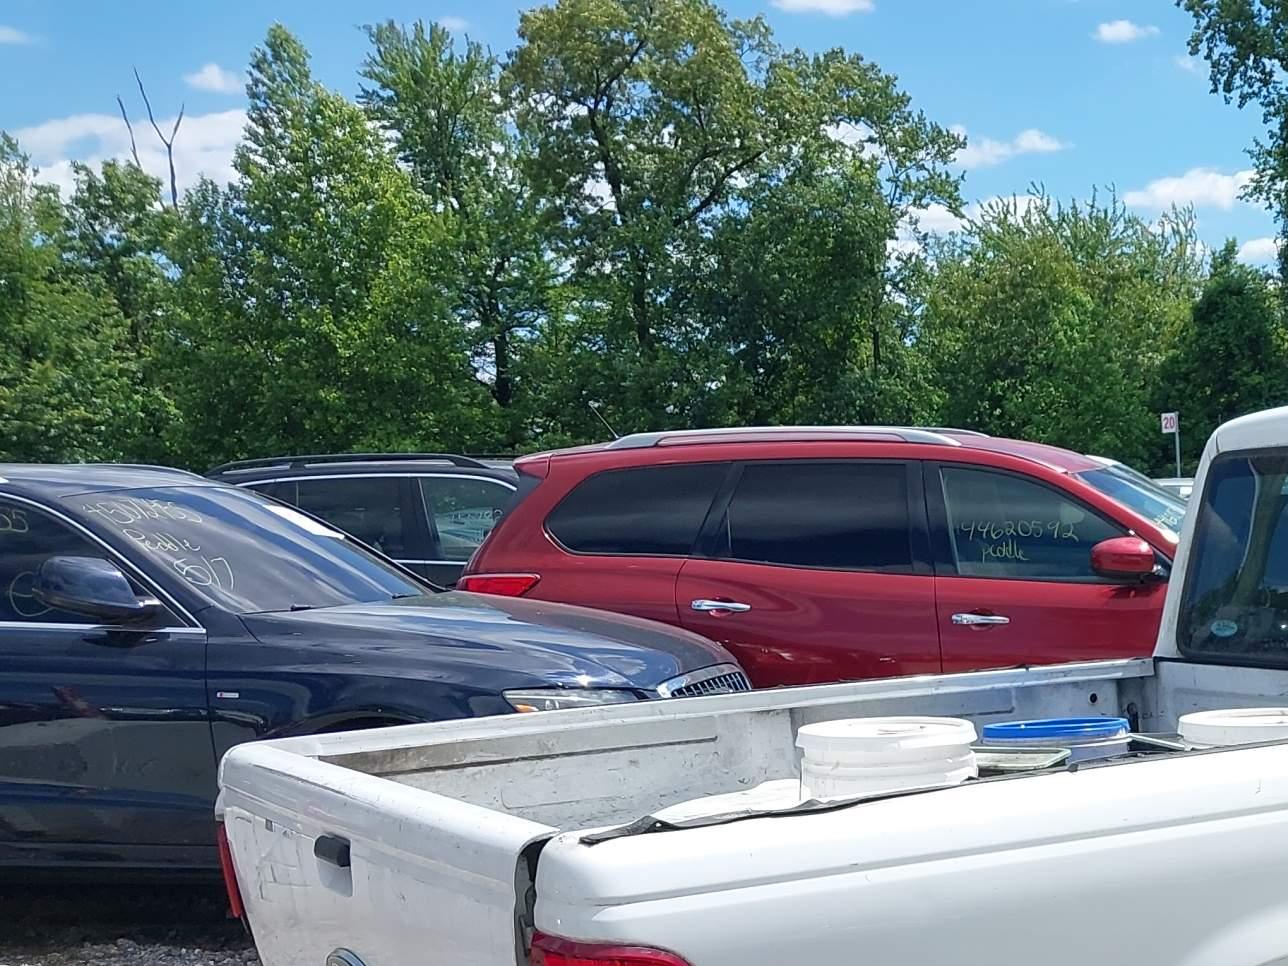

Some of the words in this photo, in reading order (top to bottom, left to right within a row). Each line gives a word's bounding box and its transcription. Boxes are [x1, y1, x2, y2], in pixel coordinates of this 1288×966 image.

[1163, 416, 1175, 430] 20
[960, 520, 1079, 543] 44620592
[174, 555, 235, 592] 5/7
